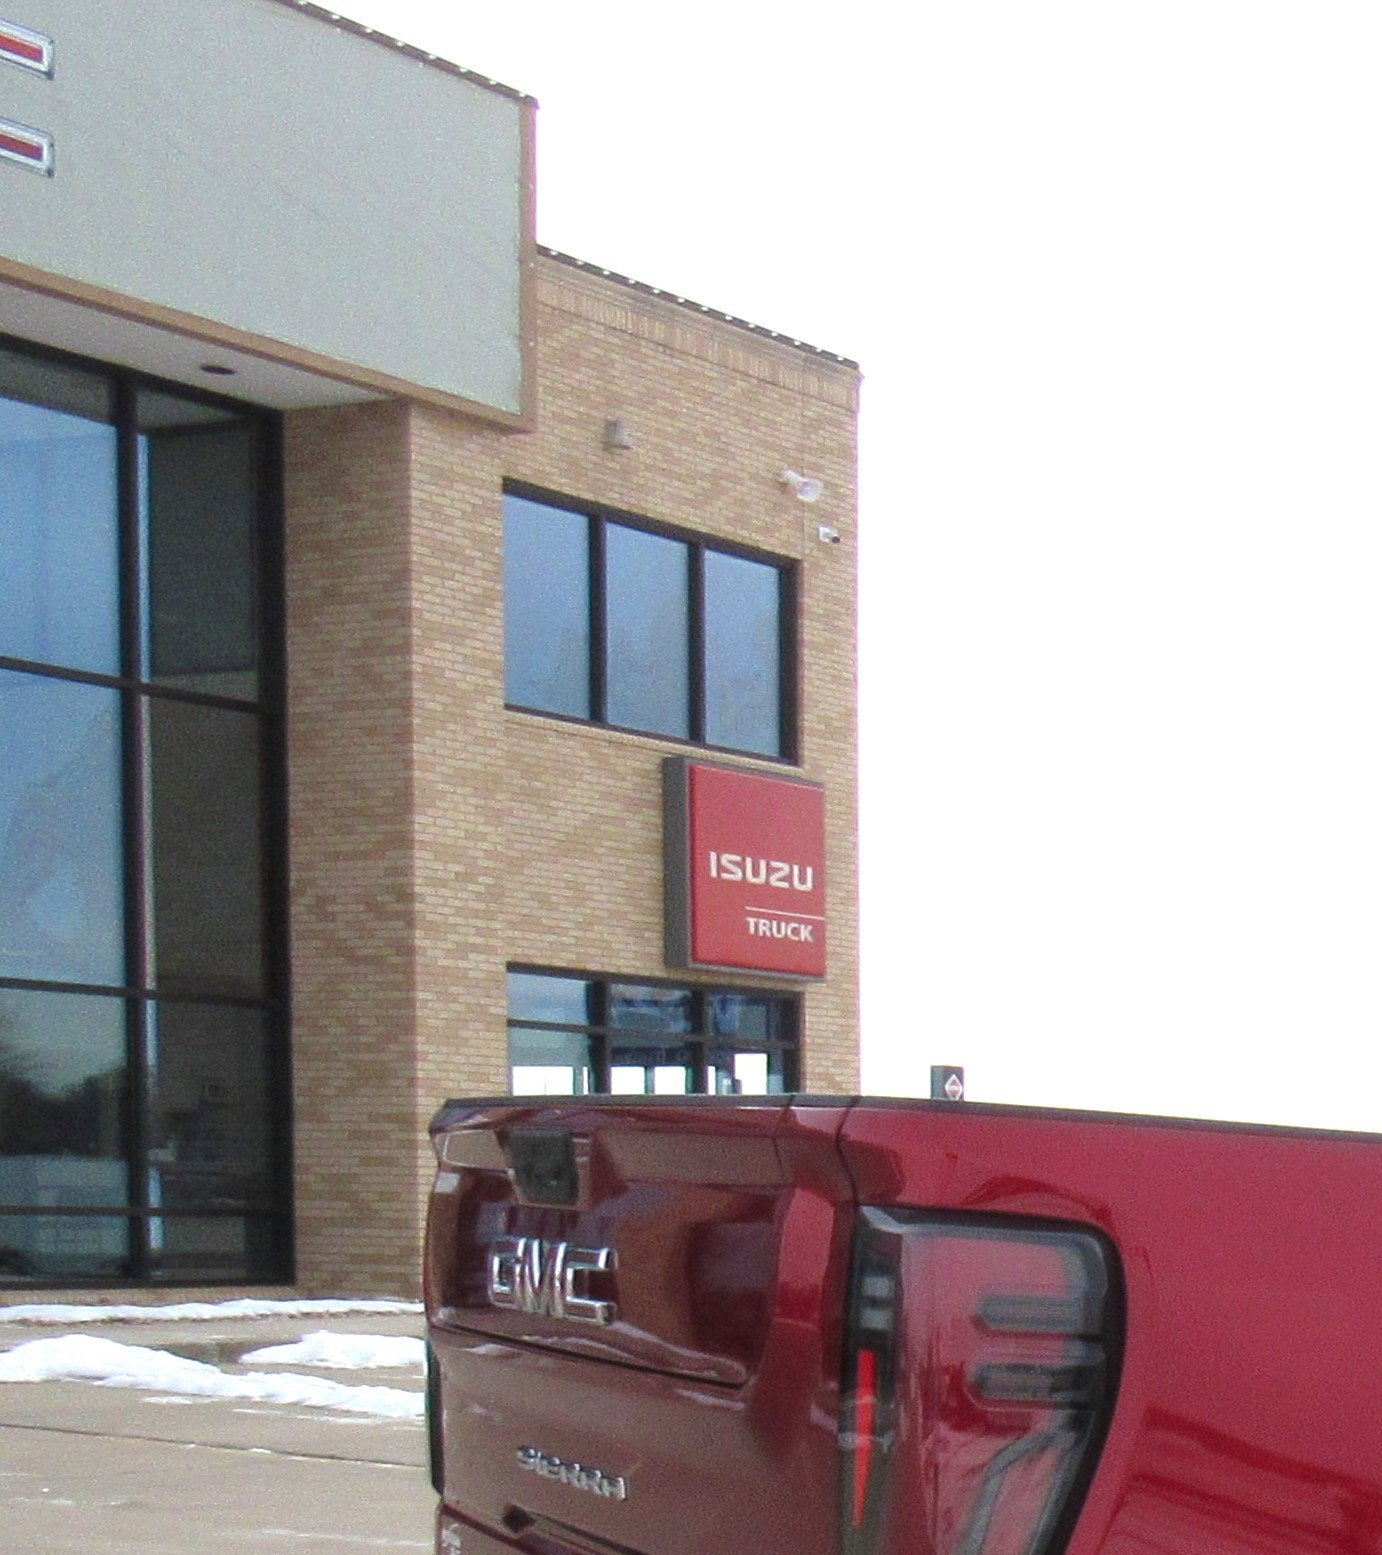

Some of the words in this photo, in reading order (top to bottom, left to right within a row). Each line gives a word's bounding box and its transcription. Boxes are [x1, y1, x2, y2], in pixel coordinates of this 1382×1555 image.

[709, 851, 813, 891] ISUZU
[746, 917, 813, 942] TRUCK
[488, 1237, 618, 1326] GMC
